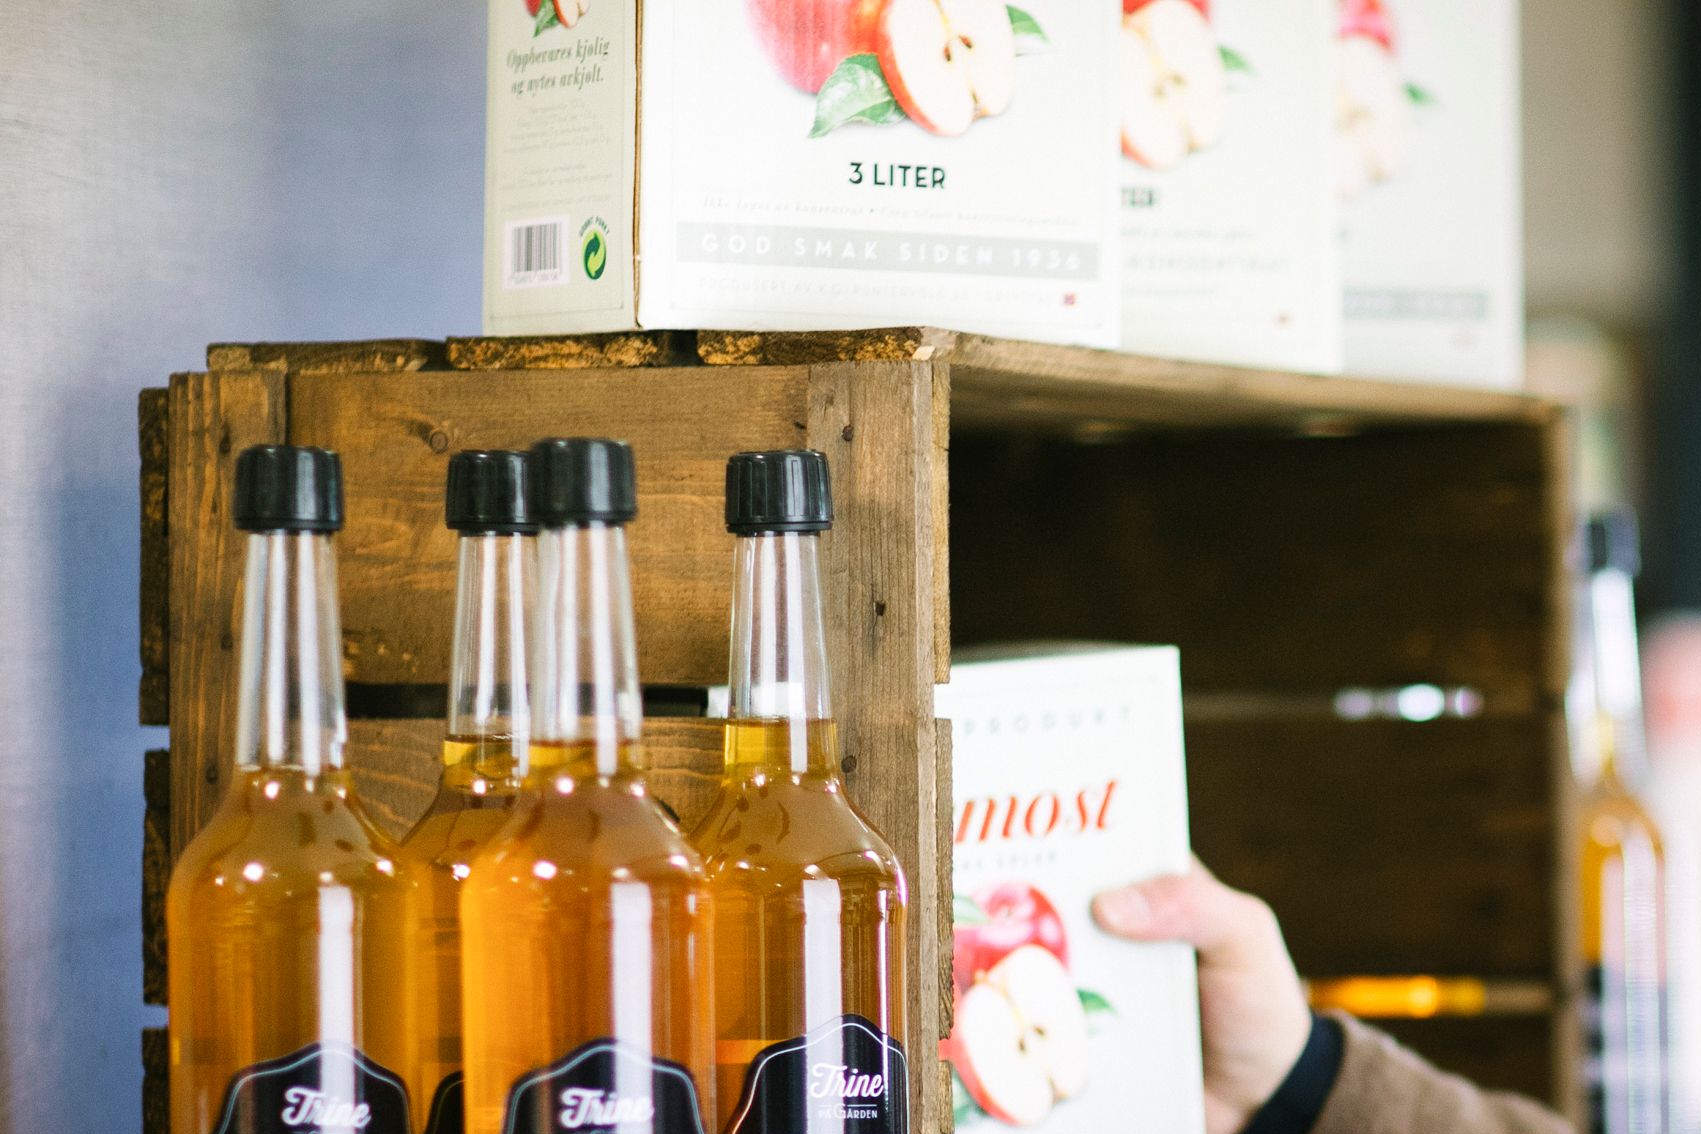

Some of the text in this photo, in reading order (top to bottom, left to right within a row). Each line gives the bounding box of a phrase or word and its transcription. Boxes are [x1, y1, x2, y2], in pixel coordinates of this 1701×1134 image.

[848, 161, 947, 190] 3 LITER
[701, 233, 771, 255] GOD
[793, 237, 879, 260] SMAK
[896, 242, 993, 266] SIDEN
[953, 777, 1119, 845] most
[810, 1062, 885, 1099] Trine
[280, 1085, 372, 1128] Trine
[560, 1086, 655, 1129] Trine
[833, 1104, 878, 1120] GÅRDEN
